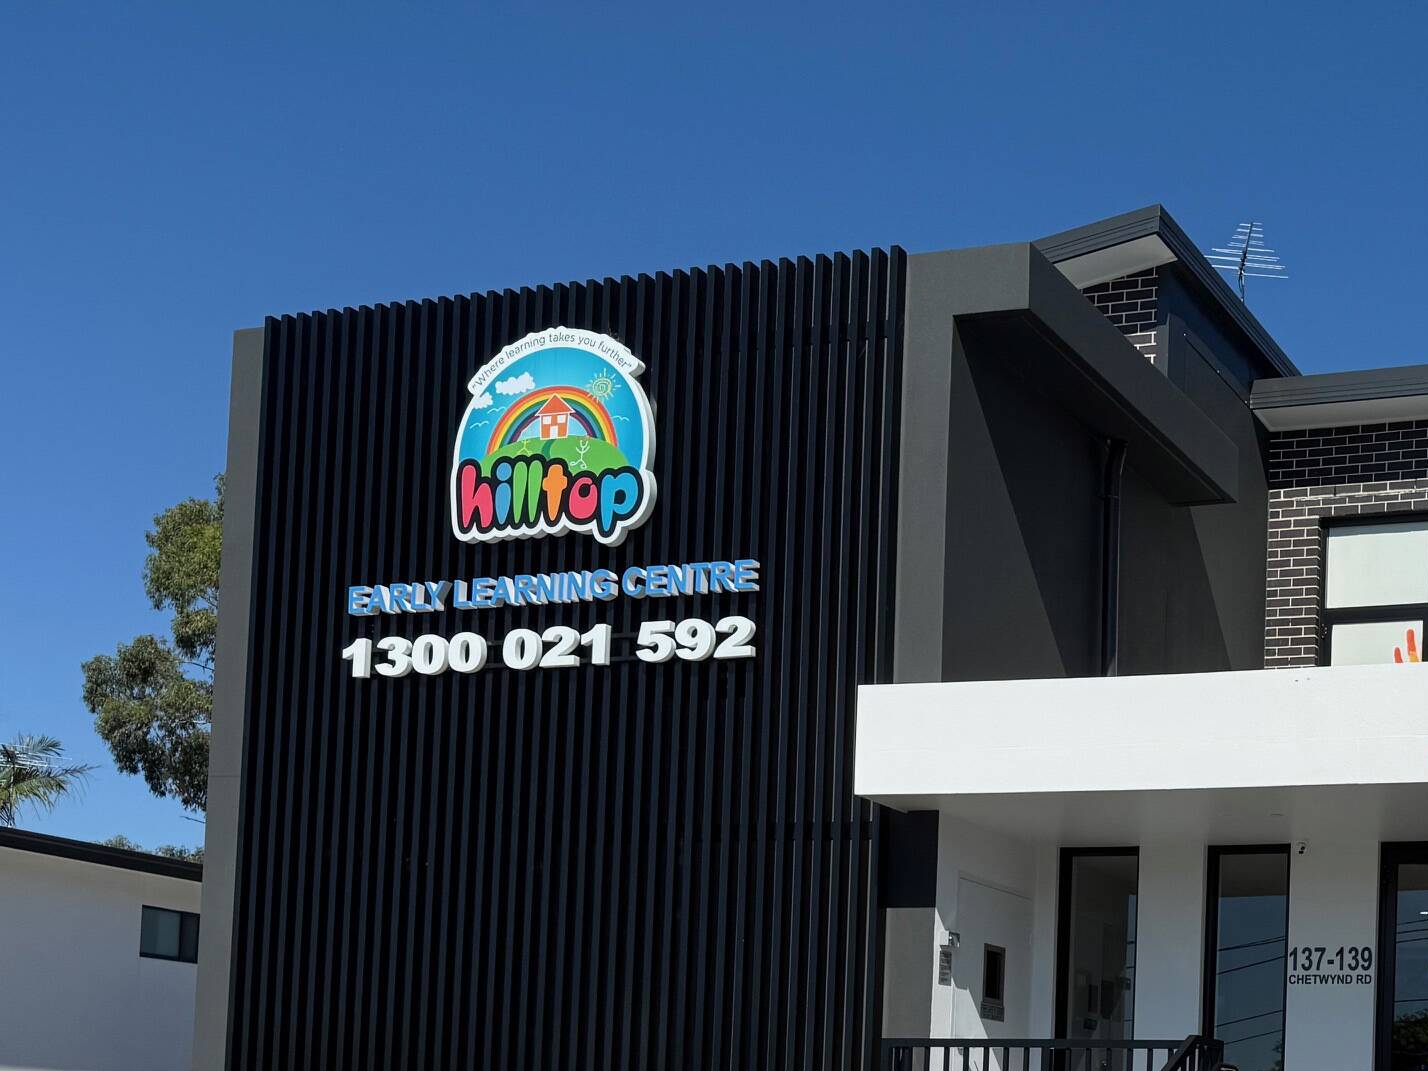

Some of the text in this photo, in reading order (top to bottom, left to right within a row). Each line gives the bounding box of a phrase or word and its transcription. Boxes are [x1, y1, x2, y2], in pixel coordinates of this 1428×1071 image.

[505, 335, 546, 361] learning
[548, 332, 575, 343] takes
[578, 335, 596, 347] you
[459, 457, 640, 534] hilltop
[348, 559, 760, 616] EARLY LEARNING CENTRE
[342, 615, 756, 678] 1300 021 592
[1288, 974, 1372, 985] CHETWYND RD
[1289, 946, 1373, 972] 137-139
